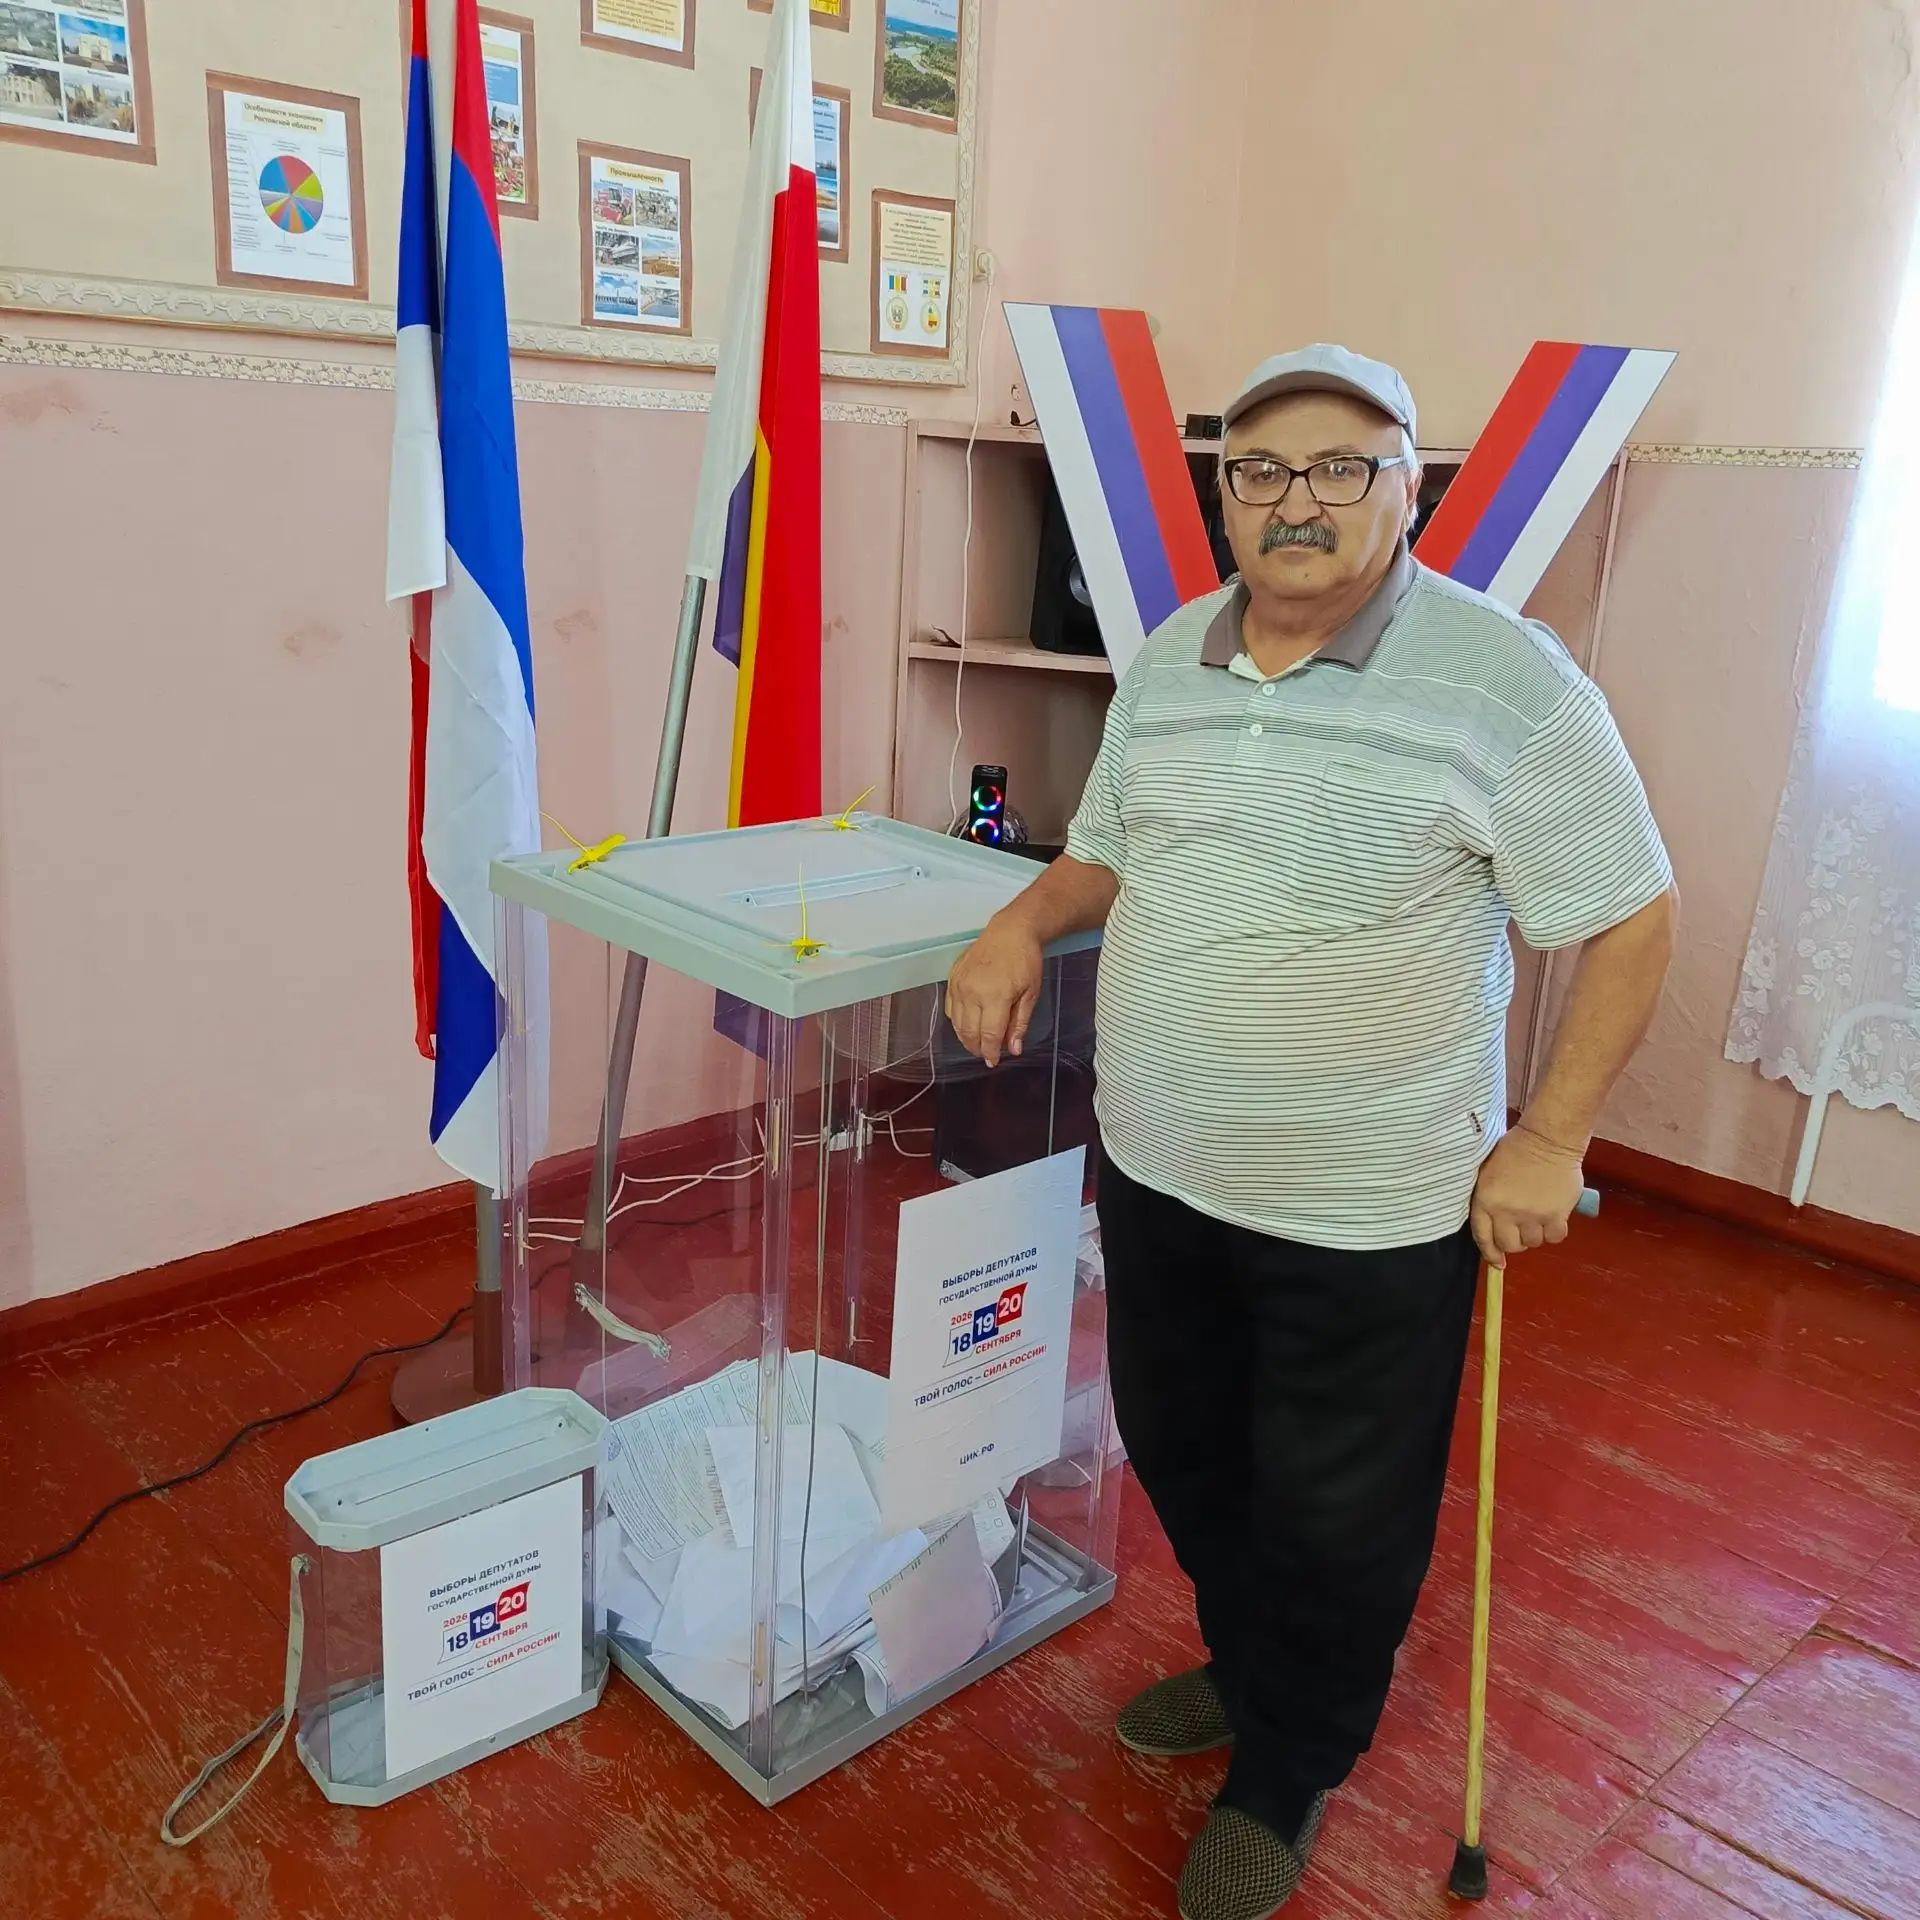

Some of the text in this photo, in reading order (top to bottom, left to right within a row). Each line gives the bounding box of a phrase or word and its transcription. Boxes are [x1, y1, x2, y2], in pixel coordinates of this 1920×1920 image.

[610, 168, 664, 184] Промышленность
[939, 1263, 1038, 1305] ГОСУДАРСТВЕННОЙ ДУМЫ
[942, 1247, 1037, 1289] ВЫБОРЫ ДЕПУТАТОВ
[951, 1310, 973, 1325] 2026
[951, 1293, 1021, 1356] 18 19 20
[975, 1329, 1021, 1355] СЕНТЯБРЯ
[914, 1384, 940, 1407] ТВОЙ
[942, 1376, 973, 1396] ГОЛОС
[983, 1360, 1008, 1378] СИЛА
[1009, 1344, 1047, 1368] РОССИИ!
[959, 1442, 995, 1465] ЦИК.РФ
[427, 1563, 542, 1612] ГОСУДАРСТВЕННОЙ ДУМЫ
[429, 1549, 539, 1598] ВЫБОРЫ ДЕПУТАТОВ
[443, 1613, 468, 1628] 2026
[446, 1591, 525, 1653] 18 19 20
[474, 1622, 528, 1649] СЕНТЯБРЯ
[407, 1682, 438, 1701] ТВОЙ
[439, 1668, 475, 1689] ГОЛОС
[487, 1652, 515, 1669] СИЛА
[516, 1632, 560, 1657] РОССИИ!
